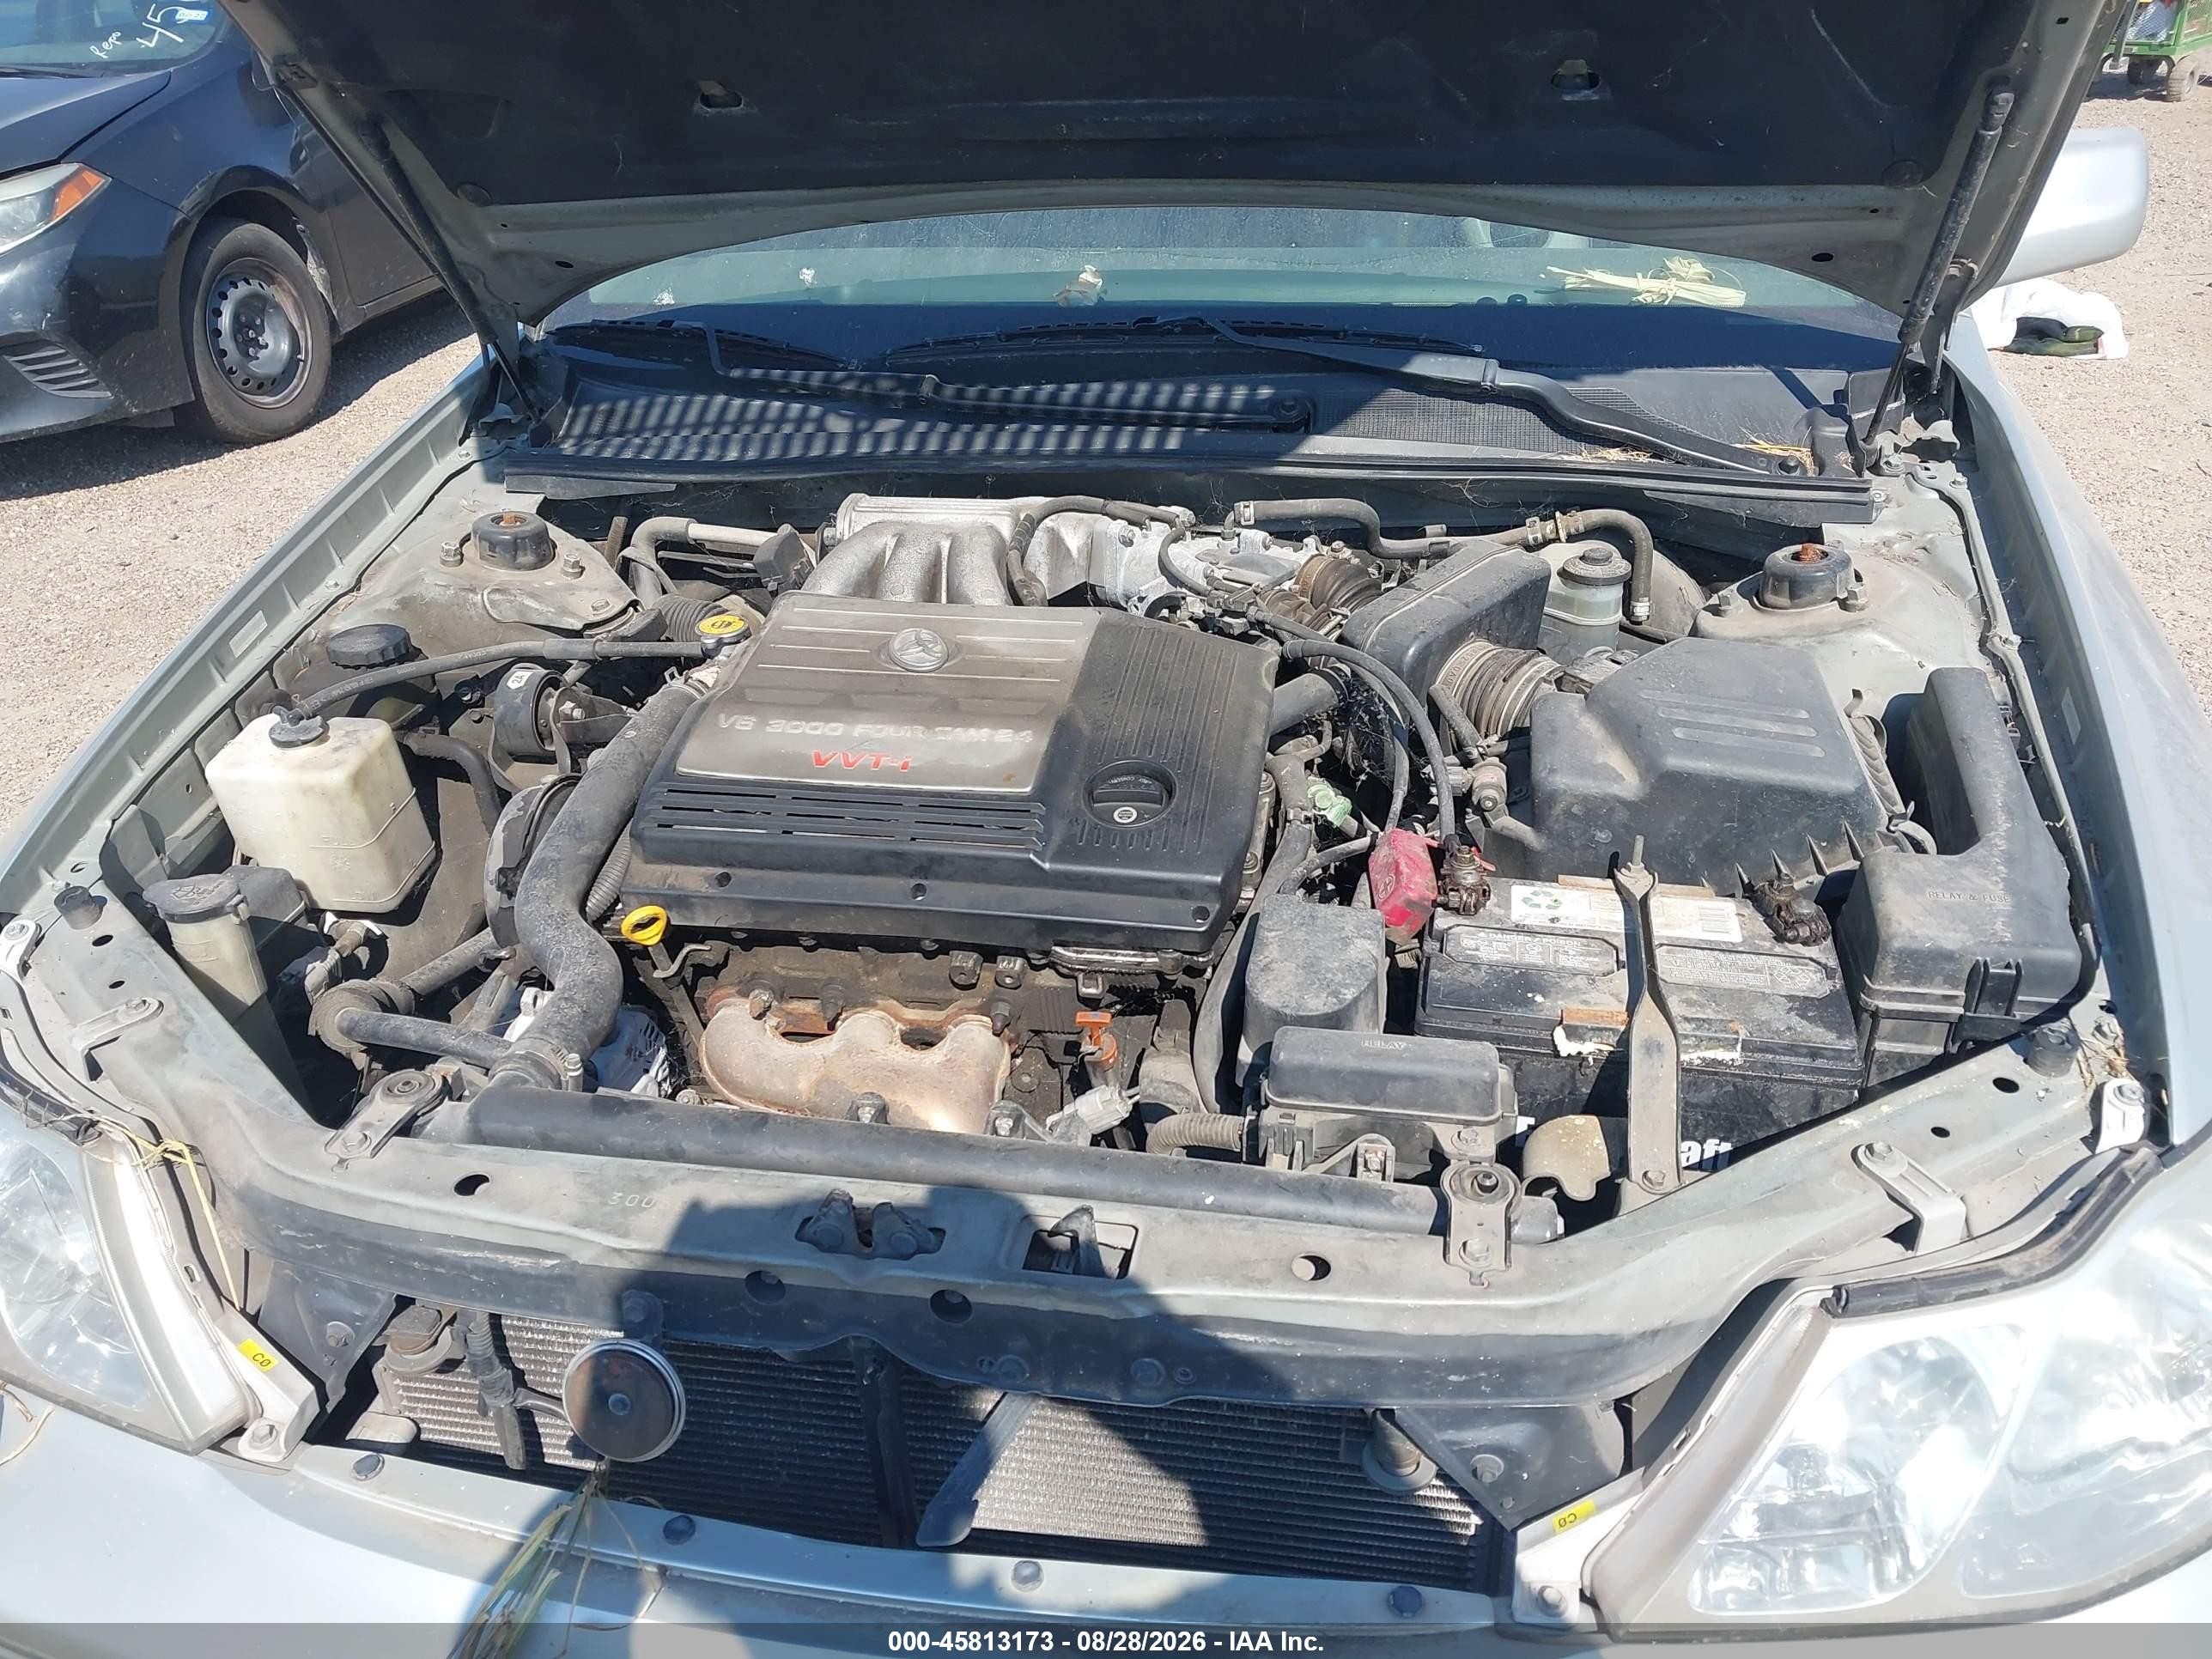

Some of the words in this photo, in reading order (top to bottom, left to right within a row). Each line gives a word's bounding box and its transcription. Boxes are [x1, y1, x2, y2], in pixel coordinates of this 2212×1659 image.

[719, 713, 757, 731] V6
[765, 719, 845, 736] 3000
[811, 750, 912, 772] VVT-i
[1927, 891, 1962, 901] RELAY
[1982, 894, 2012, 902] FUSE
[1489, 933, 1531, 943] DANGER
[1542, 939, 1580, 947] POISON
[1361, 1039, 1407, 1051] RELAY
